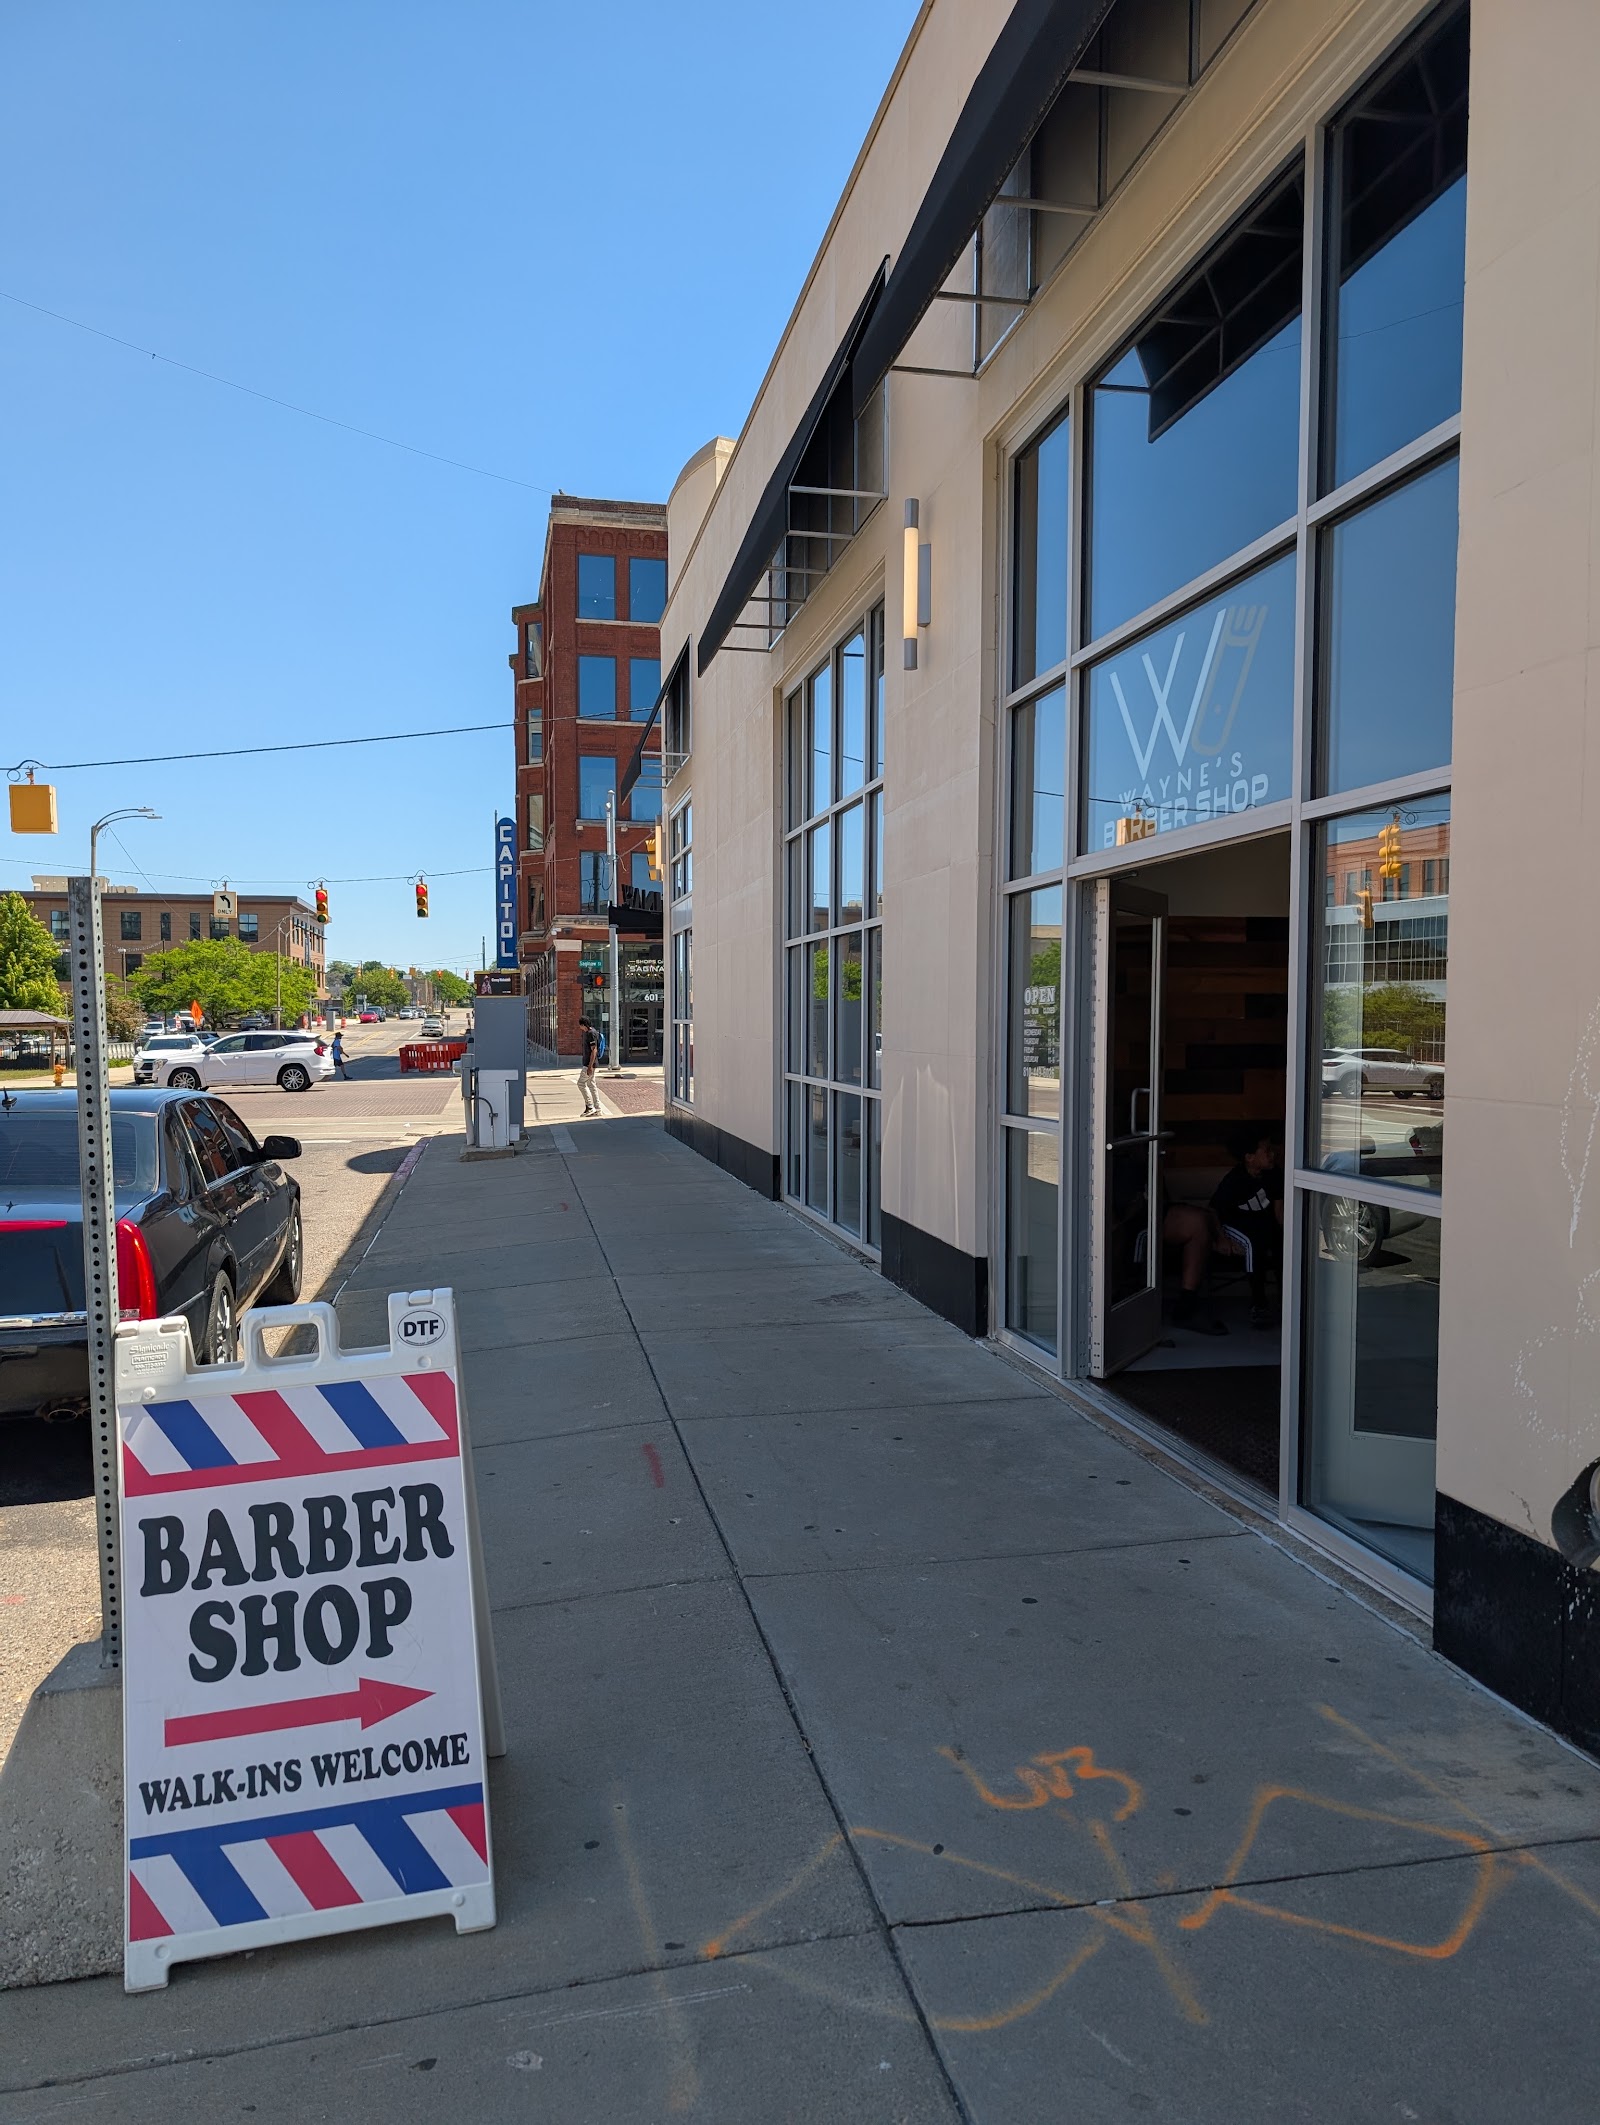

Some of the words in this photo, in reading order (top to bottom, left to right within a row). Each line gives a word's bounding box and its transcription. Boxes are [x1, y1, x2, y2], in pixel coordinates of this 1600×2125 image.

[1104, 802, 1189, 849] BARBER
[1195, 773, 1269, 822] SHOP
[1118, 751, 1243, 814] WAYNE'S
[499, 825, 514, 958] CAPITOL
[579, 960, 596, 968] Saginaw
[644, 993, 658, 1001] 601
[1024, 986, 1056, 1006] OPEN
[403, 1319, 439, 1337] DTF
[139, 1482, 455, 1598] BARBER
[188, 1576, 413, 1683] SHOP
[138, 1757, 303, 1817] WALK-INS
[311, 1732, 471, 1791] WELCOME
